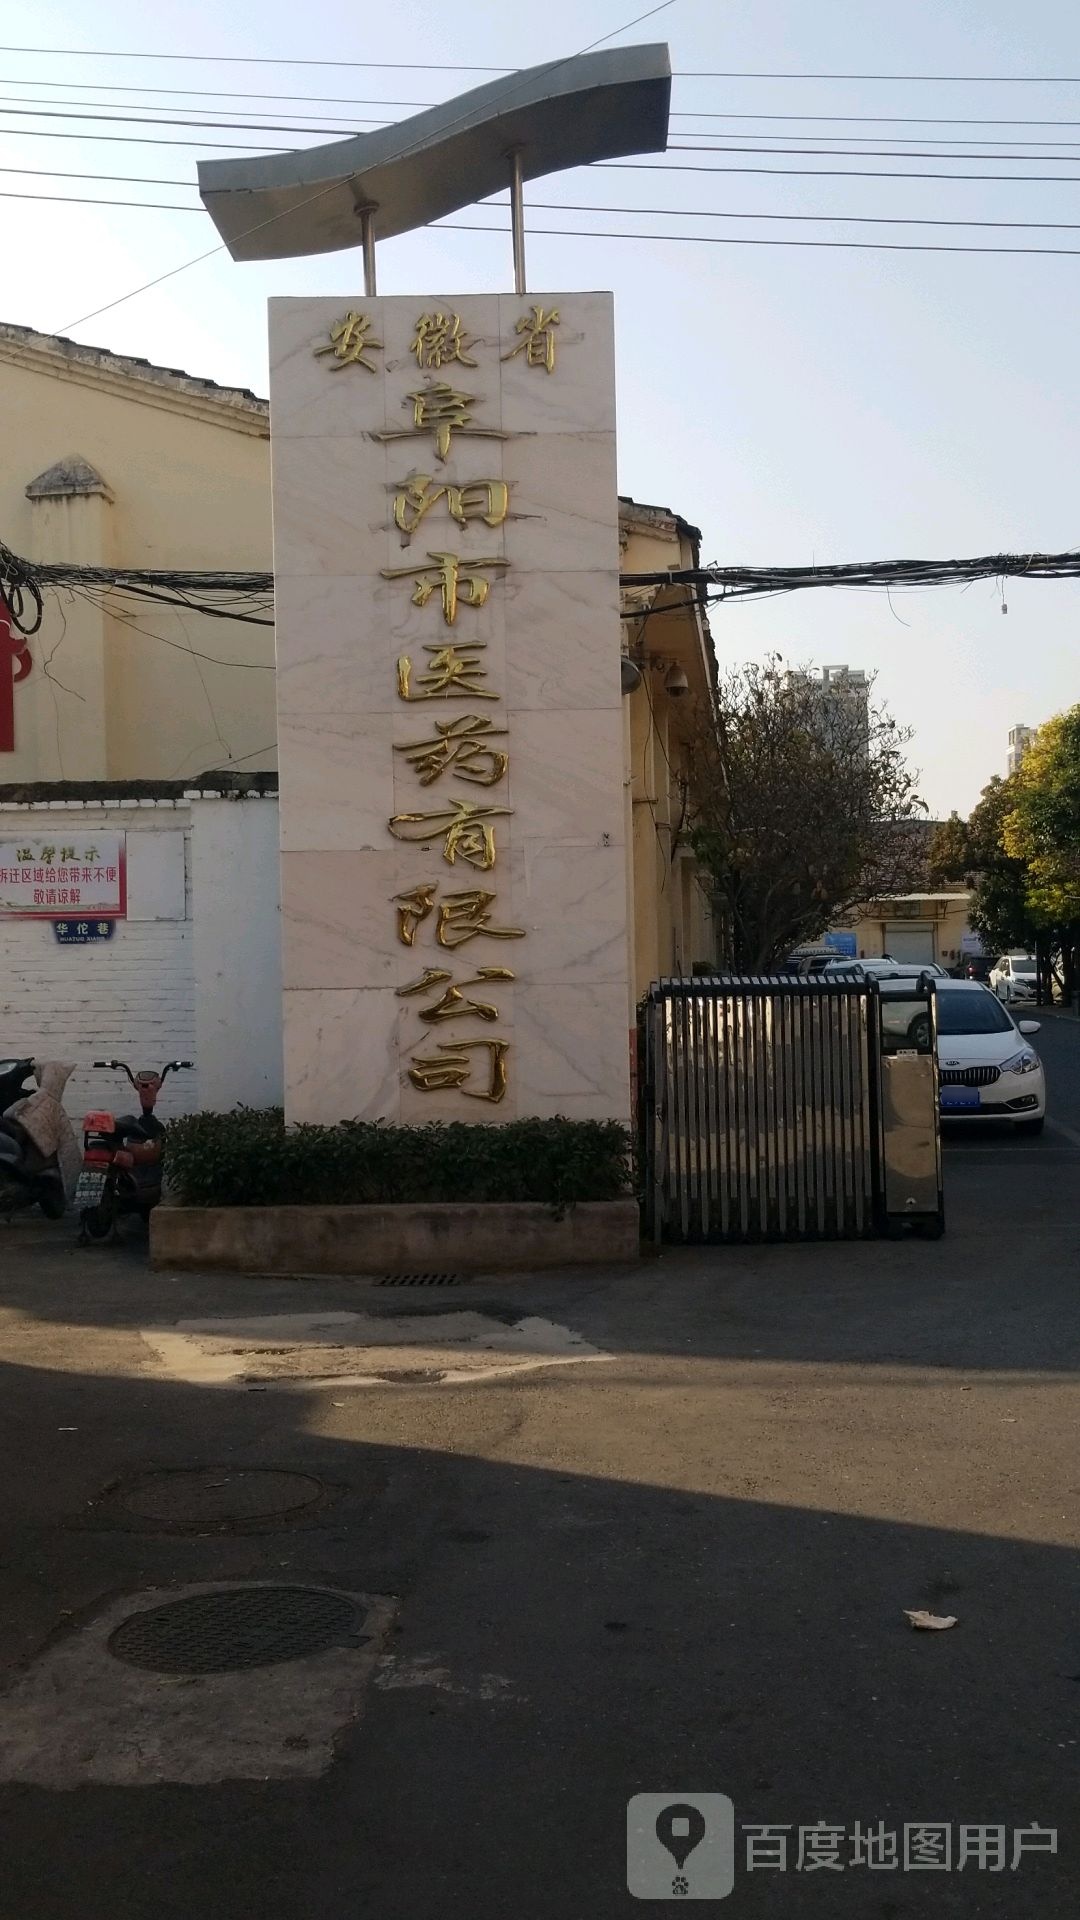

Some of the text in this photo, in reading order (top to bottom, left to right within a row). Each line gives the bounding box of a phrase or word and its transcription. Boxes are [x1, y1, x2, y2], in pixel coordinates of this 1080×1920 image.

[314, 305, 561, 375] 安徽省
[378, 382, 527, 1102] 阜阳市医药有限公司
[16, 846, 101, 864] 温馨提示
[33, 889, 81, 904] 敬请谅解
[56, 922, 109, 935] 华佗巷
